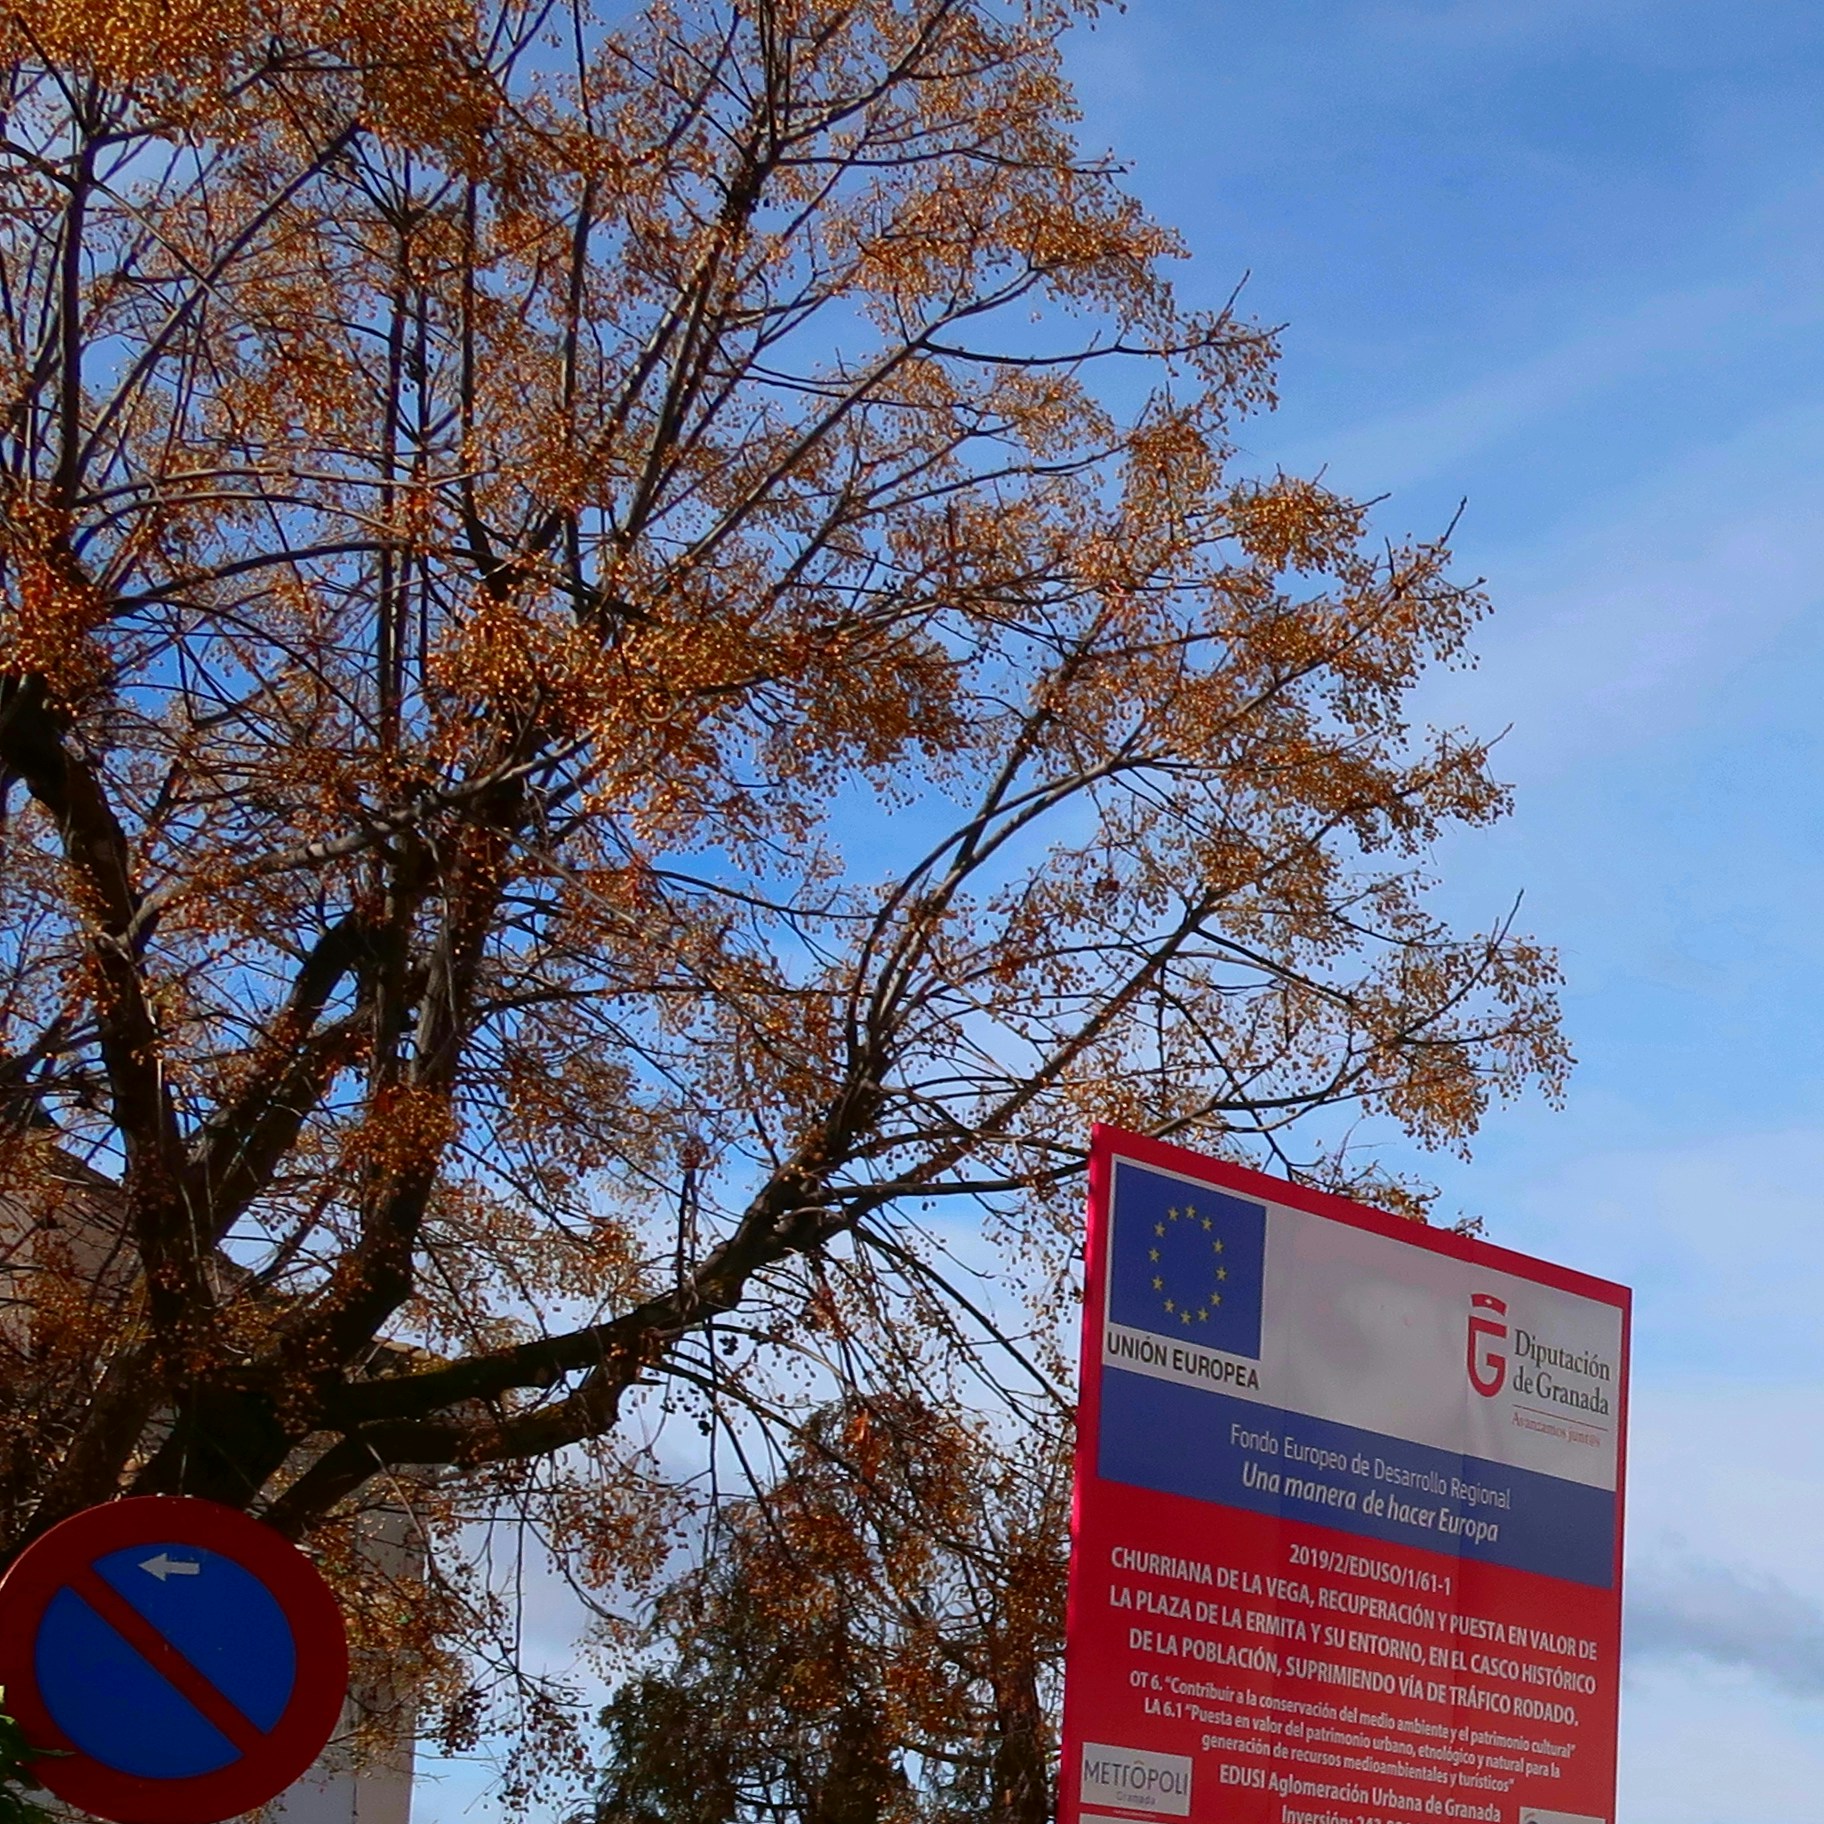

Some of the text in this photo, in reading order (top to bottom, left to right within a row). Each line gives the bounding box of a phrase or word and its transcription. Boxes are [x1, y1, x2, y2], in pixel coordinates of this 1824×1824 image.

[1107, 1332, 1260, 1390] UNIÓN EUROPEA
[1513, 1366, 1609, 1415] de Granada
[1514, 1328, 1610, 1381] Diputación
[1230, 1423, 1511, 1510] Fondo Europeo de Desarrollo Regional
[1242, 1461, 1499, 1545] Una manera de hacer Europa
[1111, 1547, 1597, 1661] CHURRIANA DE LA VEGA, RECUPERACIÓN Y PUESTA EN VALOR DE
[1289, 1544, 1452, 1596] 2019/2/EDUSO/1/61-1
[1110, 1585, 1596, 1694] LA PLAZA DE LA ERMITA Y SU ENTORNO, EN EL CASCO HISTÓRICO
[1129, 1628, 1579, 1726] DE LA POBLACIÓN, SUPRIMIENDO VÍA DE TRÁFICO RODADO.
[1129, 1670, 1148, 1688] OT
[1151, 1674, 1163, 1691] 6.
[1236, 1691, 1244, 1704] a
[1246, 1689, 1257, 1706] la
[1259, 1695, 1337, 1720] conservación
[1339, 1705, 1357, 1723] del
[1359, 1711, 1395, 1730] medio
[1397, 1717, 1449, 1738] ambiente
[1450, 1728, 1457, 1743] y
[1458, 1726, 1469, 1741] el
[1470, 1730, 1530, 1751] patrimonio
[1144, 1697, 1161, 1715] LA
[1163, 1701, 1182, 1718] 6.1
[1235, 1715, 1250, 1729] en
[1252, 1715, 1282, 1735] valor
[1285, 1720, 1304, 1738] del
[1305, 1727, 1371, 1749] patrimonio
[1373, 1736, 1416, 1758] urbano,
[1418, 1744, 1475, 1766] etnológico
[1477, 1754, 1485, 1770] y
[1486, 1755, 1525, 1773] natural
[1525, 1763, 1549, 1778] para
[1550, 1762, 1561, 1778] la
[1202, 1734, 1270, 1757] generación
[1273, 1742, 1289, 1759] de
[1290, 1748, 1342, 1768] recursos
[1343, 1755, 1448, 1784] medioambientales
[1449, 1772, 1457, 1787] y
[1219, 1764, 1502, 1823] EDUSI Aglomeración Urbana de Granada
